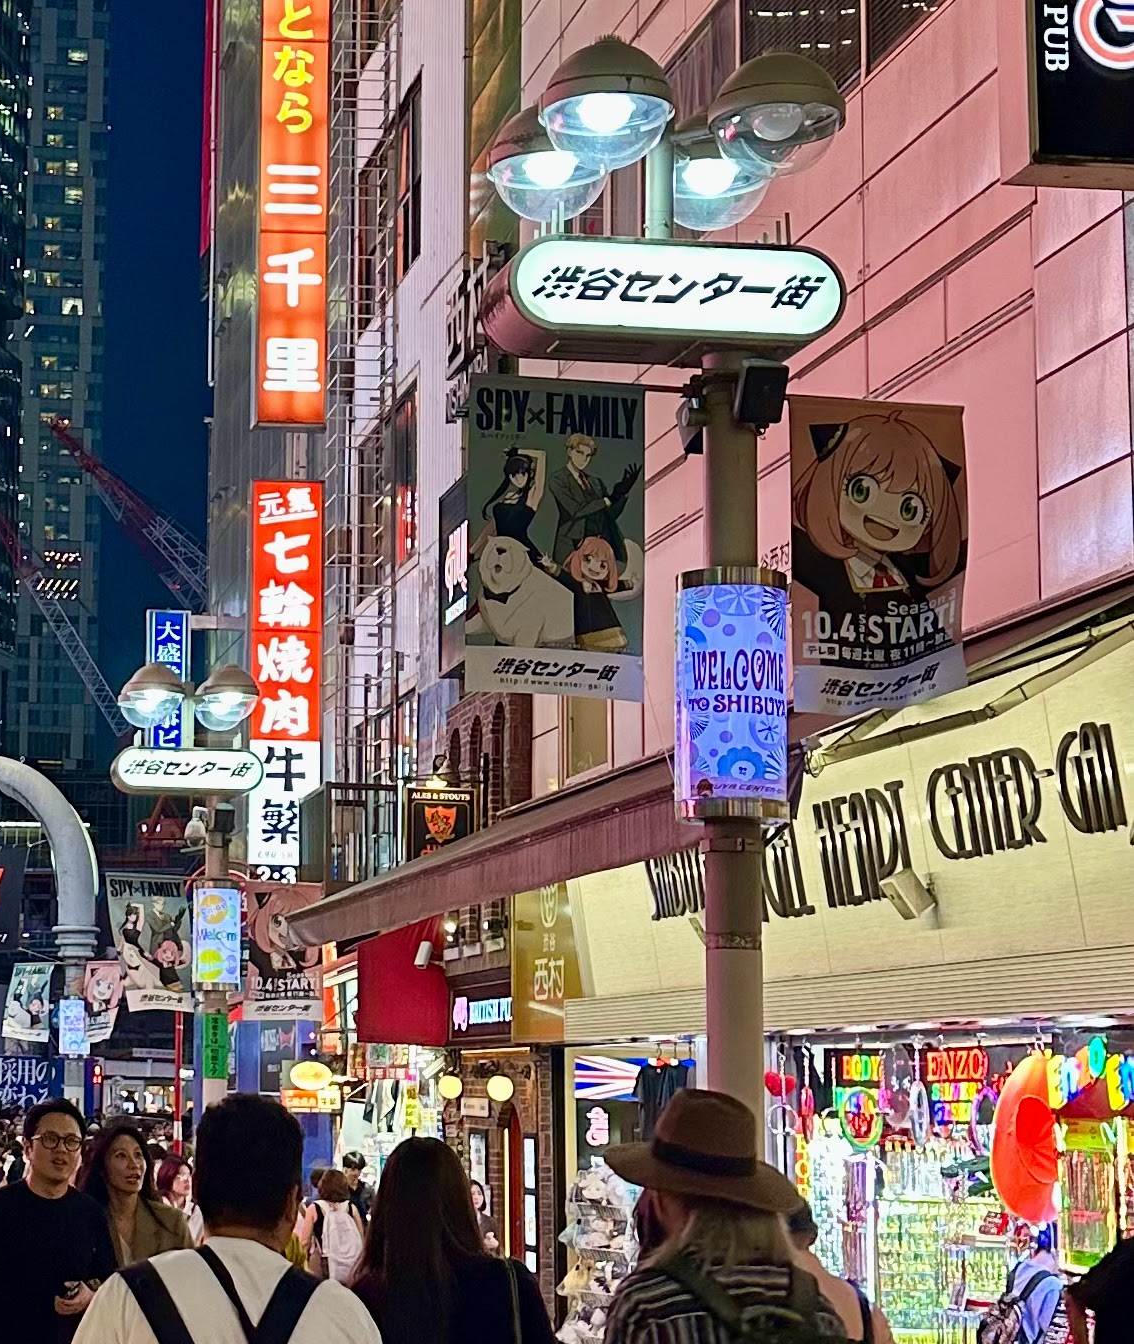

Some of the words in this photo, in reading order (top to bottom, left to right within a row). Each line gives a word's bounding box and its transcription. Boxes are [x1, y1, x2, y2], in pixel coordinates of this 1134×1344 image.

[1044, 4, 1071, 72] PUB
[262, 163, 324, 394] 三千里
[532, 265, 827, 310] 渋谷センター街
[802, 610, 856, 642] 10.4
[867, 602, 956, 645] START!
[887, 596, 945, 616] Season
[257, 530, 315, 738] 七輪焼肉
[493, 657, 621, 682] 渋谷センター街
[691, 648, 785, 692] WELCOME
[821, 662, 940, 698] 渋谷センター街
[124, 758, 255, 778] 渋谷センター街
[261, 746, 306, 845] 牛繁
[411, 791, 431, 799] ALES
[439, 792, 471, 801] STOUTS
[533, 957, 565, 1001] 西村
[926, 1049, 987, 1082] ENZO
